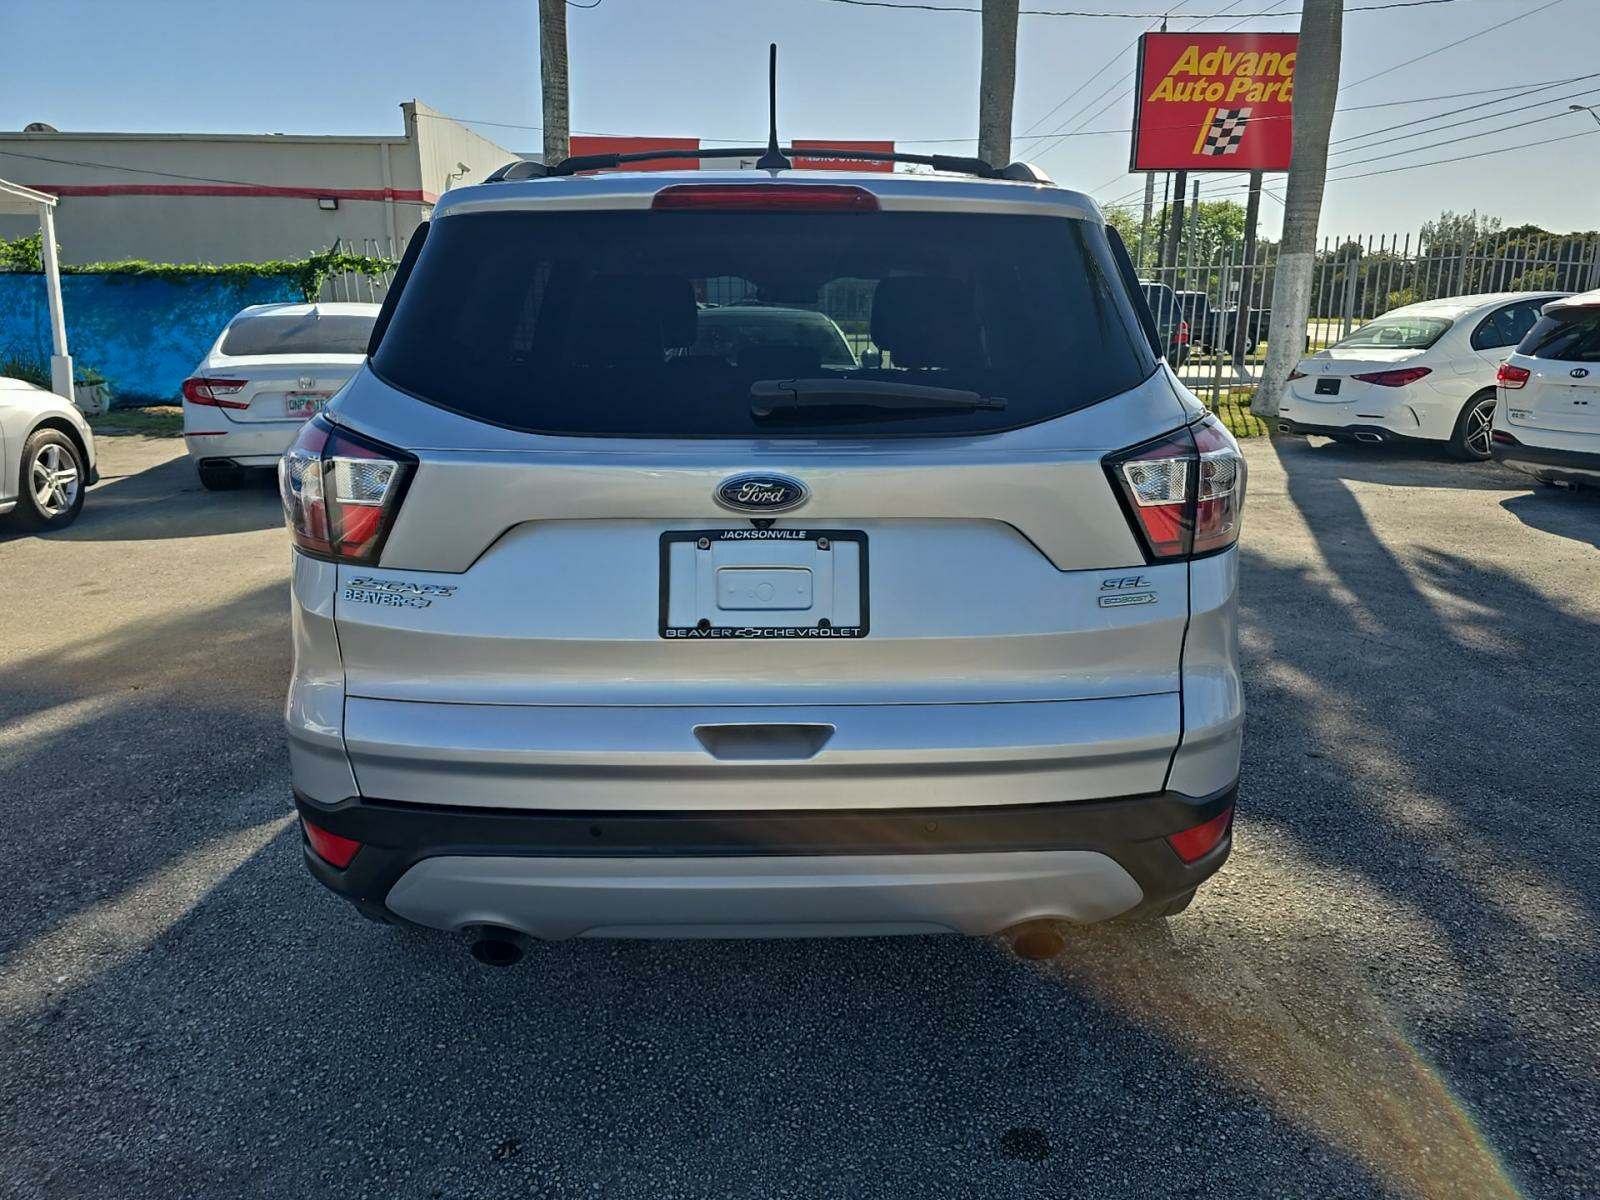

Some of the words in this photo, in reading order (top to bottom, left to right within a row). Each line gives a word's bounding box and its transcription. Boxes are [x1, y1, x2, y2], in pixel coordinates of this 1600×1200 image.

[1168, 45, 1297, 77] Advanc
[1148, 77, 1225, 102] Auto
[1225, 77, 1293, 102] Part
[737, 481, 786, 503] Ford
[720, 530, 807, 540] JACKSONVILLE
[1100, 575, 1151, 591] SEL
[343, 589, 403, 607] BEAVER
[665, 628, 732, 638] BEAVER
[763, 628, 861, 638] CHEVROLET
